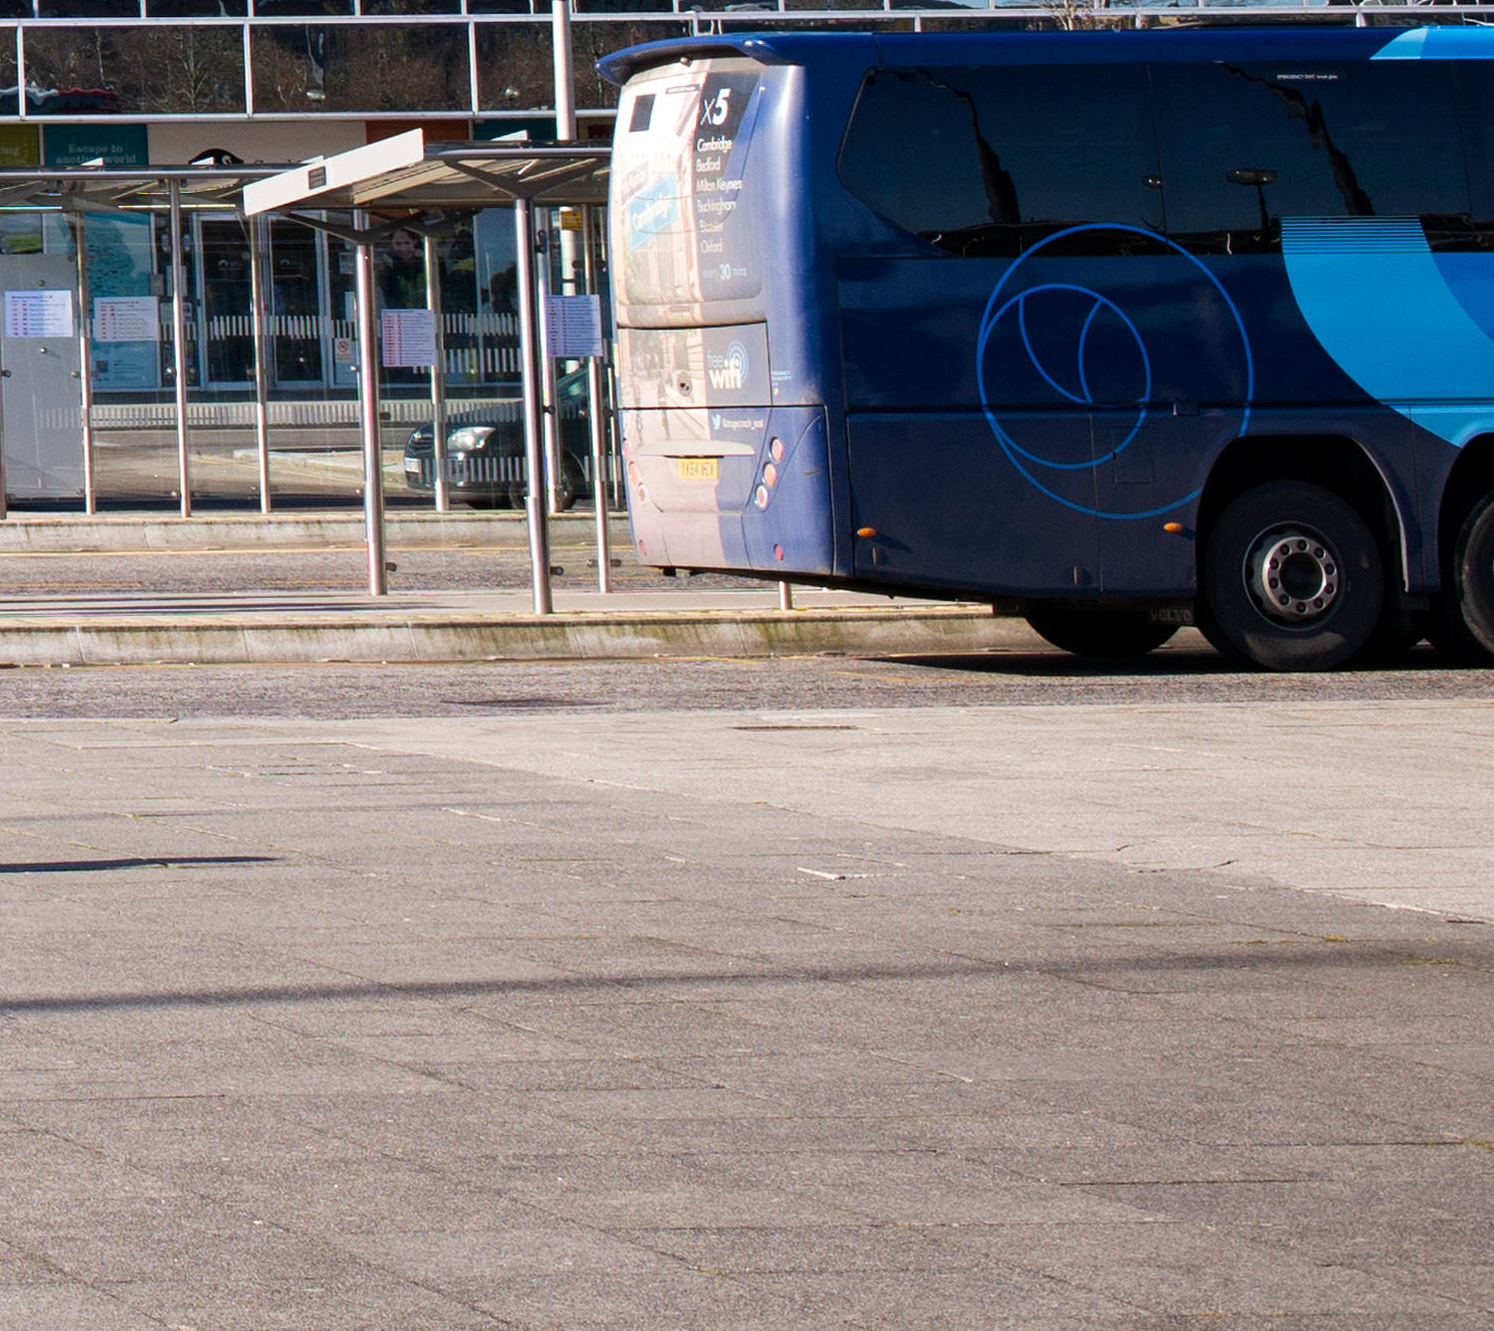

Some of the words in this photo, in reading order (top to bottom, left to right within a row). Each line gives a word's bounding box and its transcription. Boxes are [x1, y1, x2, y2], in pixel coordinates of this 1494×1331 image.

[68, 144, 108, 155] Escape
[111, 144, 124, 154] to
[697, 136, 733, 153] Cambridge
[696, 157, 721, 172] Bedford
[696, 178, 716, 193] Milton
[716, 177, 743, 193] Keynes
[697, 198, 737, 215] Buckingham
[719, 263, 731, 280] 30
[708, 357, 742, 389] wifi
[1150, 608, 1191, 621] VOLVO
